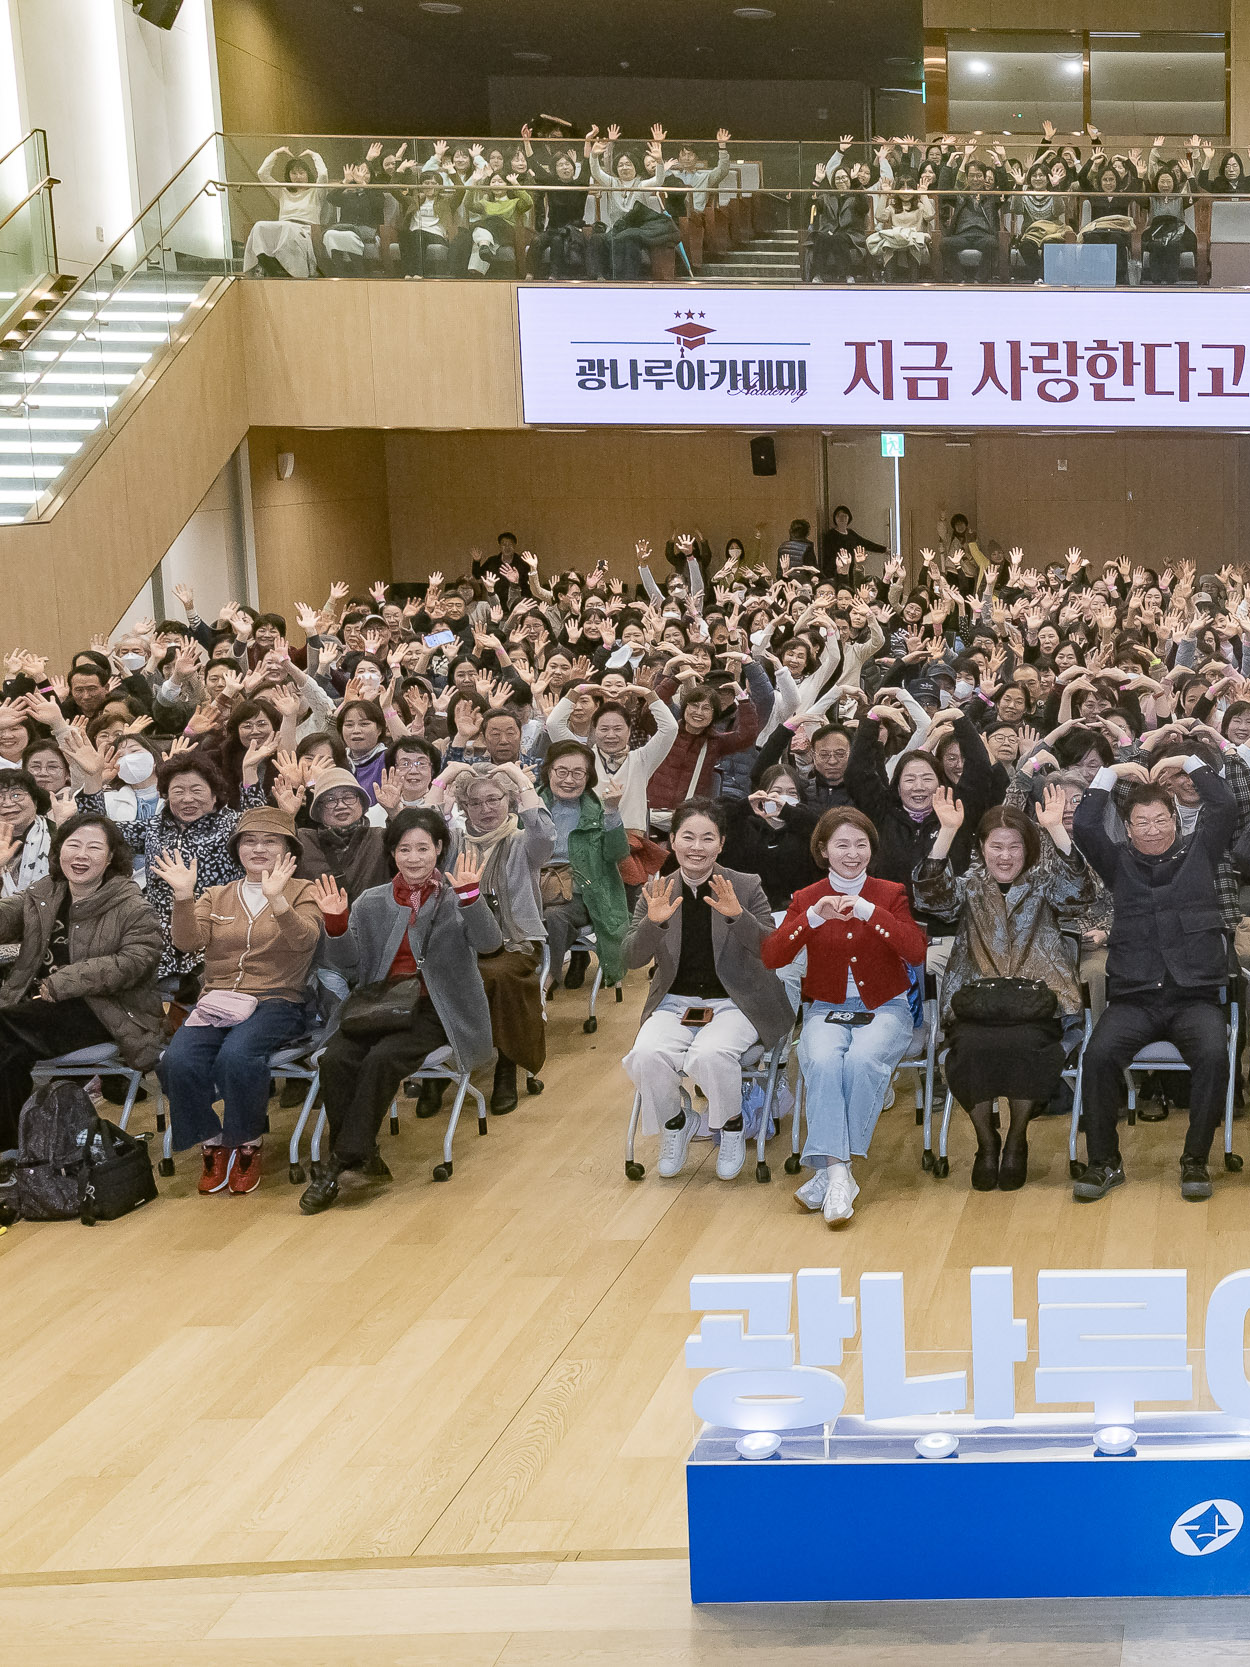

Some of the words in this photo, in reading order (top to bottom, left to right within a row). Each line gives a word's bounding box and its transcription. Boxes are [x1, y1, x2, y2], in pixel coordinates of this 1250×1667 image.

[576, 359, 806, 391] 광나루아카데미
[843, 340, 952, 400] 지금
[972, 340, 1249, 404] 사랑한다고
[727, 377, 808, 403] Academy
